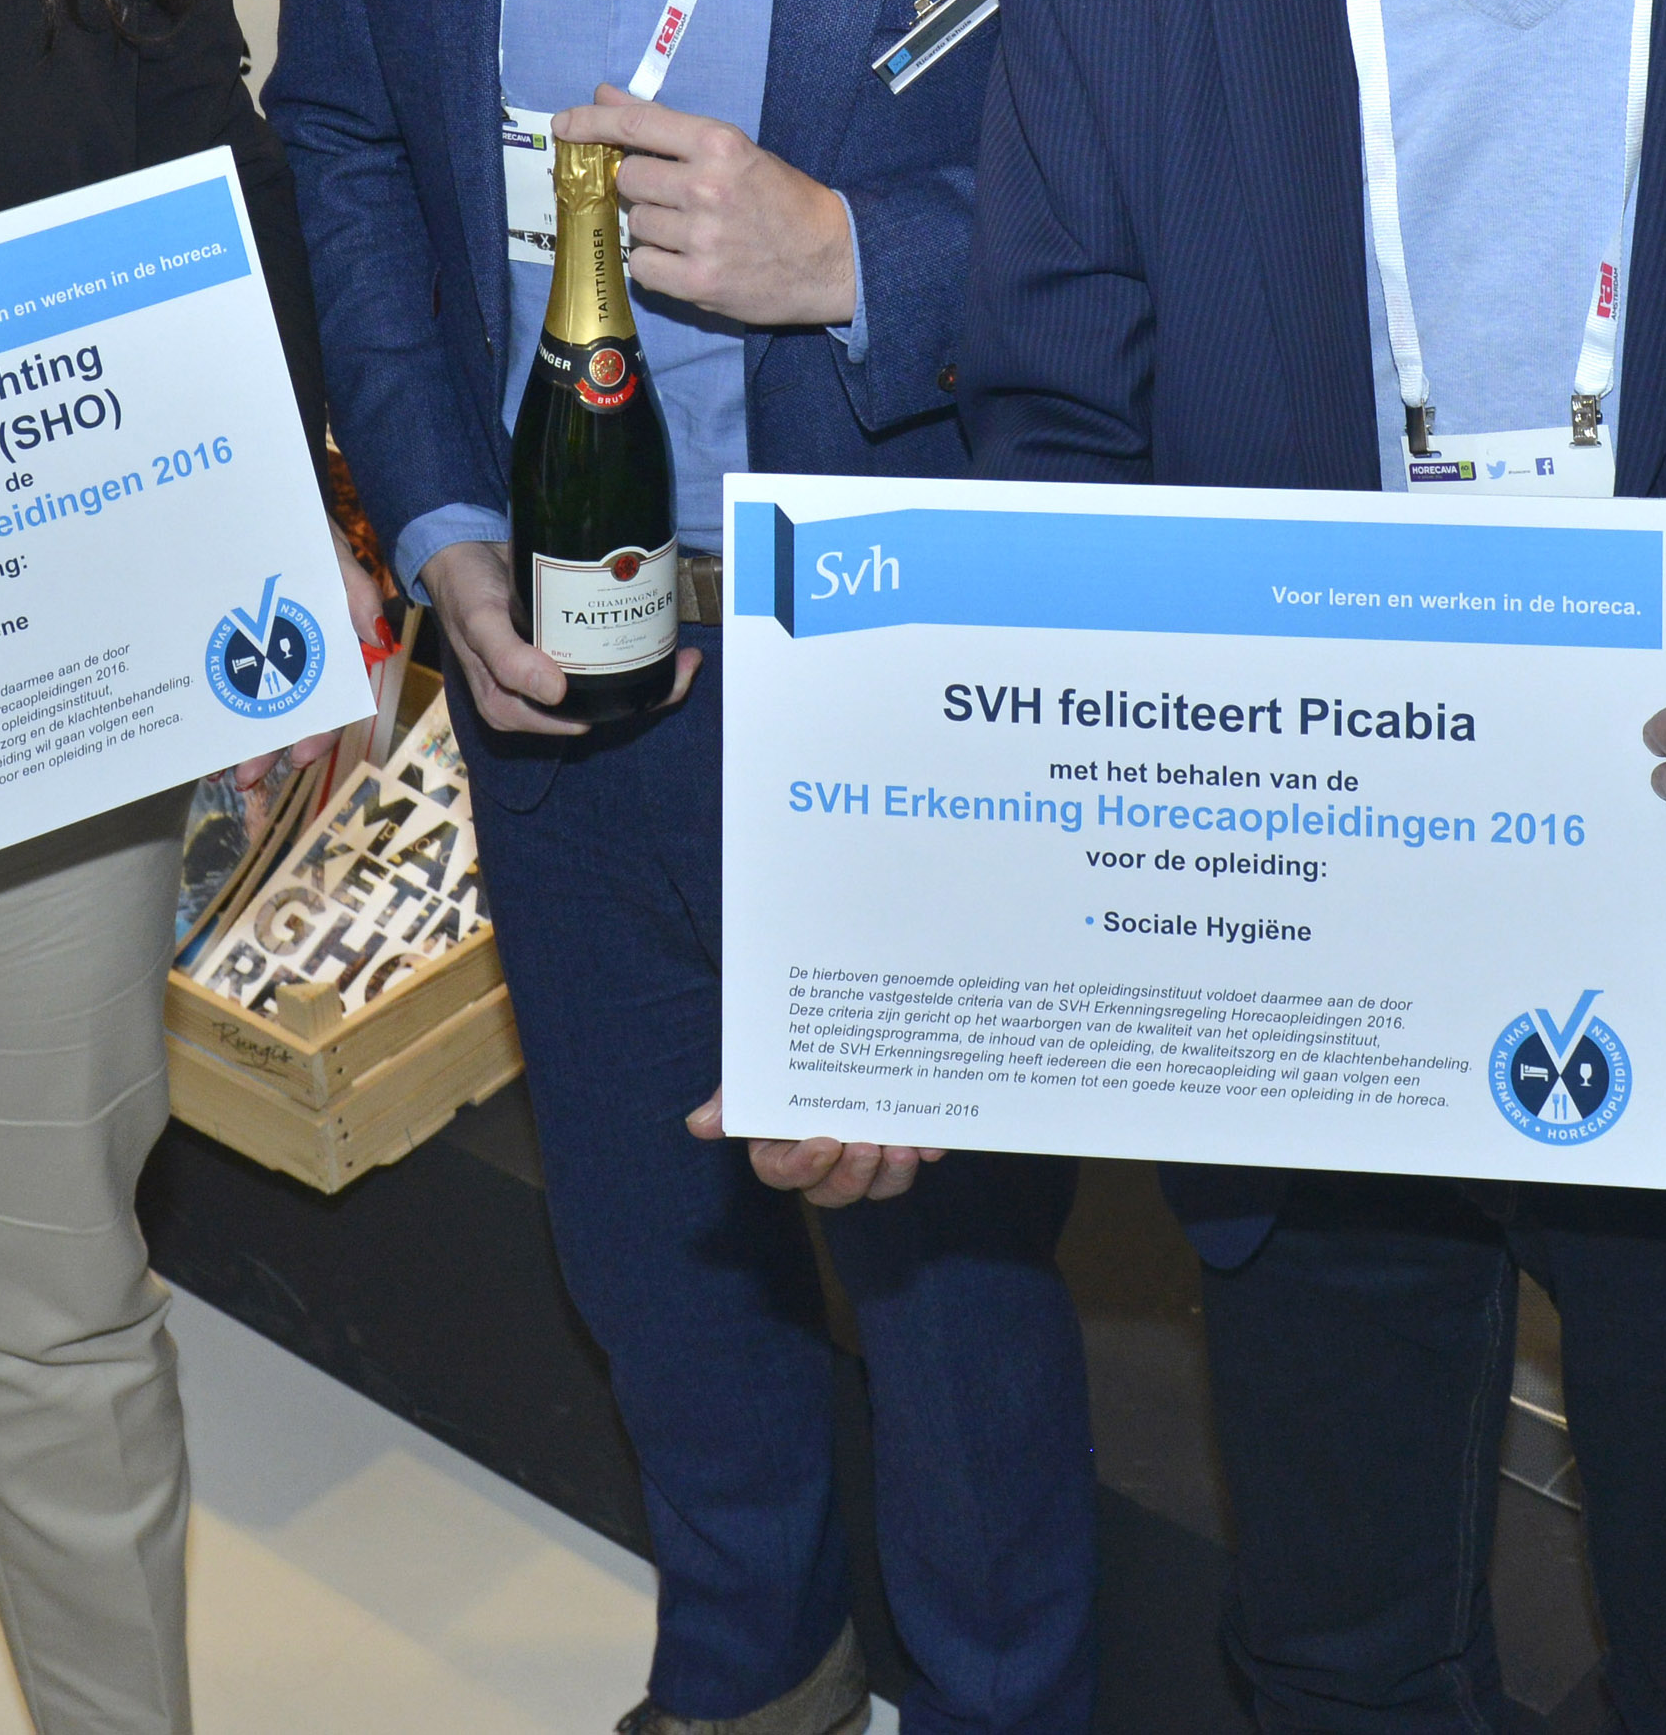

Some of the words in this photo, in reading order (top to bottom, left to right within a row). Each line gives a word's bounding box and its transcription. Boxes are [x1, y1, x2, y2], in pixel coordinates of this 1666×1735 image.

[503, 132, 531, 143] RECAVA
[13, 299, 37, 316] en
[39, 277, 107, 307] werken
[110, 270, 129, 286] in
[133, 261, 156, 279] de
[158, 242, 227, 271] horeca.
[593, 228, 609, 323] TAITTINGER
[597, 394, 625, 405] BRUT
[151, 435, 232, 485] 2016
[1412, 465, 1458, 475] HORECAVA
[4, 471, 33, 492] de
[810, 543, 899, 600] Svh
[562, 591, 673, 624] TAITTINGER
[588, 588, 658, 608] CHAMPAGNE
[1271, 585, 1323, 605] Voor
[1328, 587, 1380, 607] leren
[1387, 593, 1413, 608] en
[1419, 591, 1496, 610] werken
[1503, 593, 1522, 612] in
[1528, 594, 1555, 613] de
[1562, 594, 1641, 615] horeca.
[942, 683, 1041, 724] SVH
[1057, 687, 1282, 734] feliciteert
[1299, 697, 1475, 741] Picabia
[1049, 760, 1098, 781] met
[1106, 760, 1147, 783] het
[1156, 762, 1260, 787] behalen
[1269, 772, 1316, 790] van
[1326, 769, 1358, 792] de
[788, 780, 868, 815] SVH
[884, 784, 1082, 833] Erkenning
[1097, 793, 1475, 848] Horecaopleidingen
[1490, 811, 1585, 846] 2016
[1085, 850, 1146, 869] voor
[1153, 848, 1185, 871] de
[1194, 851, 1326, 882] opleiding:
[1103, 910, 1197, 936] Sociale
[1206, 915, 1311, 944] Hygiëne
[788, 965, 808, 979] De
[811, 967, 878, 983] hierboven
[882, 973, 954, 987] genoemde
[958, 976, 1020, 993] opleiding
[1024, 981, 1049, 992] van
[1052, 980, 1075, 993] het
[1078, 981, 1202, 1000] opleidingsinstituut
[1206, 988, 1257, 1003] voldoet
[1260, 990, 1323, 1006] daarmee
[1326, 996, 1353, 1008] aan
[1357, 995, 1375, 1009] de
[1379, 997, 1413, 1010] door
[788, 1093, 869, 1112] Amsterdam,
[875, 1099, 891, 1112] 13
[892, 1099, 941, 1115] januari
[944, 1102, 979, 1117] 2016
